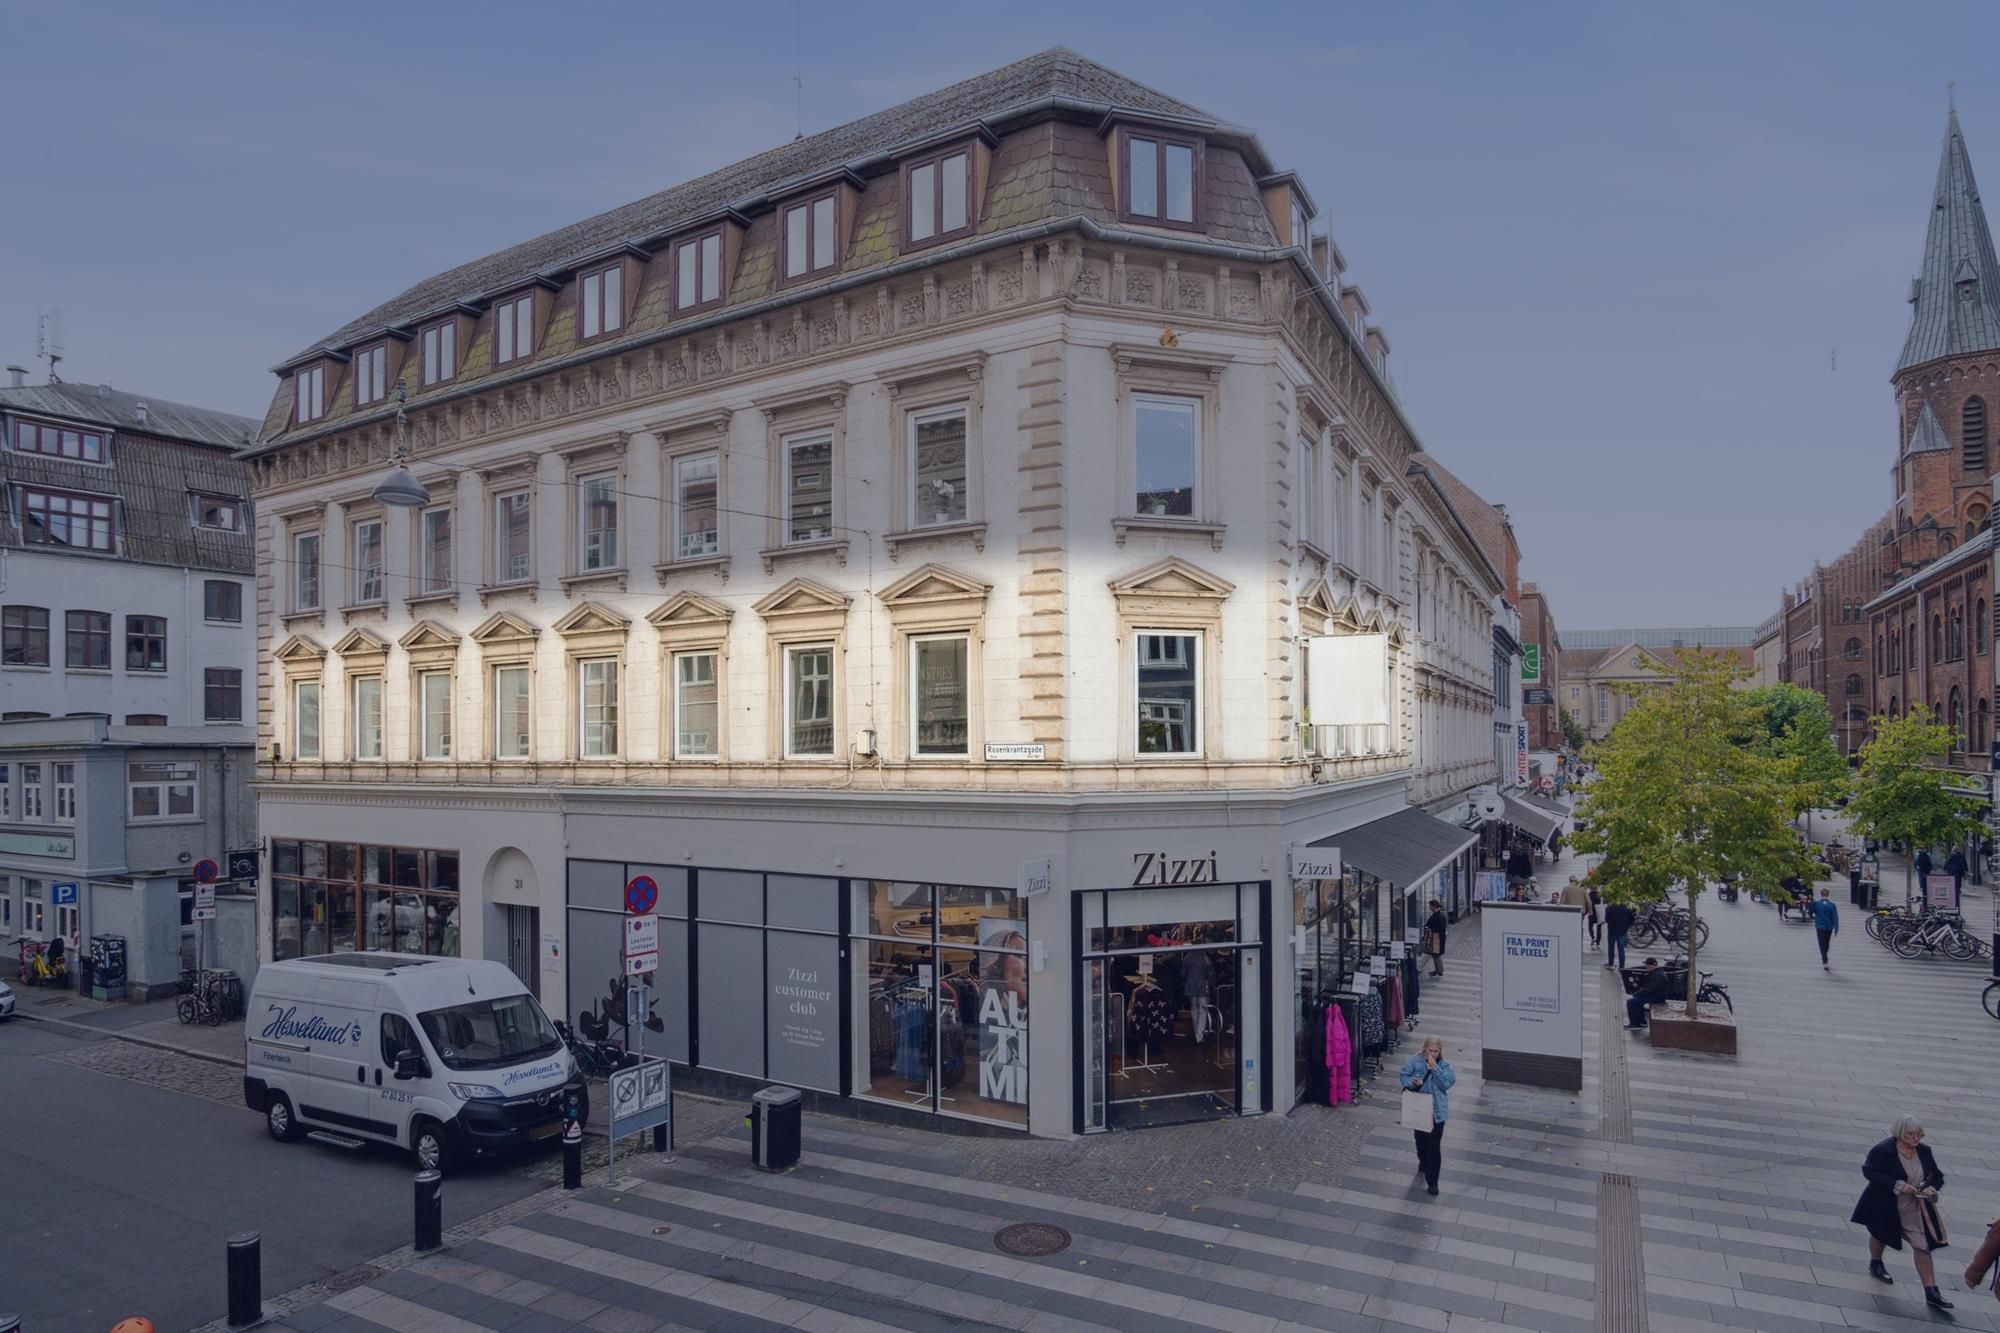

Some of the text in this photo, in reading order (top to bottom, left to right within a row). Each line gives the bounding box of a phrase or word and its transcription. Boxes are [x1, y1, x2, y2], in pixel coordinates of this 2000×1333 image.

[987, 745, 1043, 756] Rosenkrantzgade
[1518, 725, 1526, 776] INTERSPORT
[1132, 850, 1220, 886] Zizzi
[1298, 862, 1333, 876] Zizzi
[1027, 876, 1046, 893] Zizzi
[57, 885, 74, 903] P
[1506, 936, 1550, 949] FRA PRINT
[1507, 946, 1549, 958] TIL PIXELS
[788, 967, 817, 983] Zizzi
[775, 984, 832, 1001] customer
[789, 1001, 816, 1016] club
